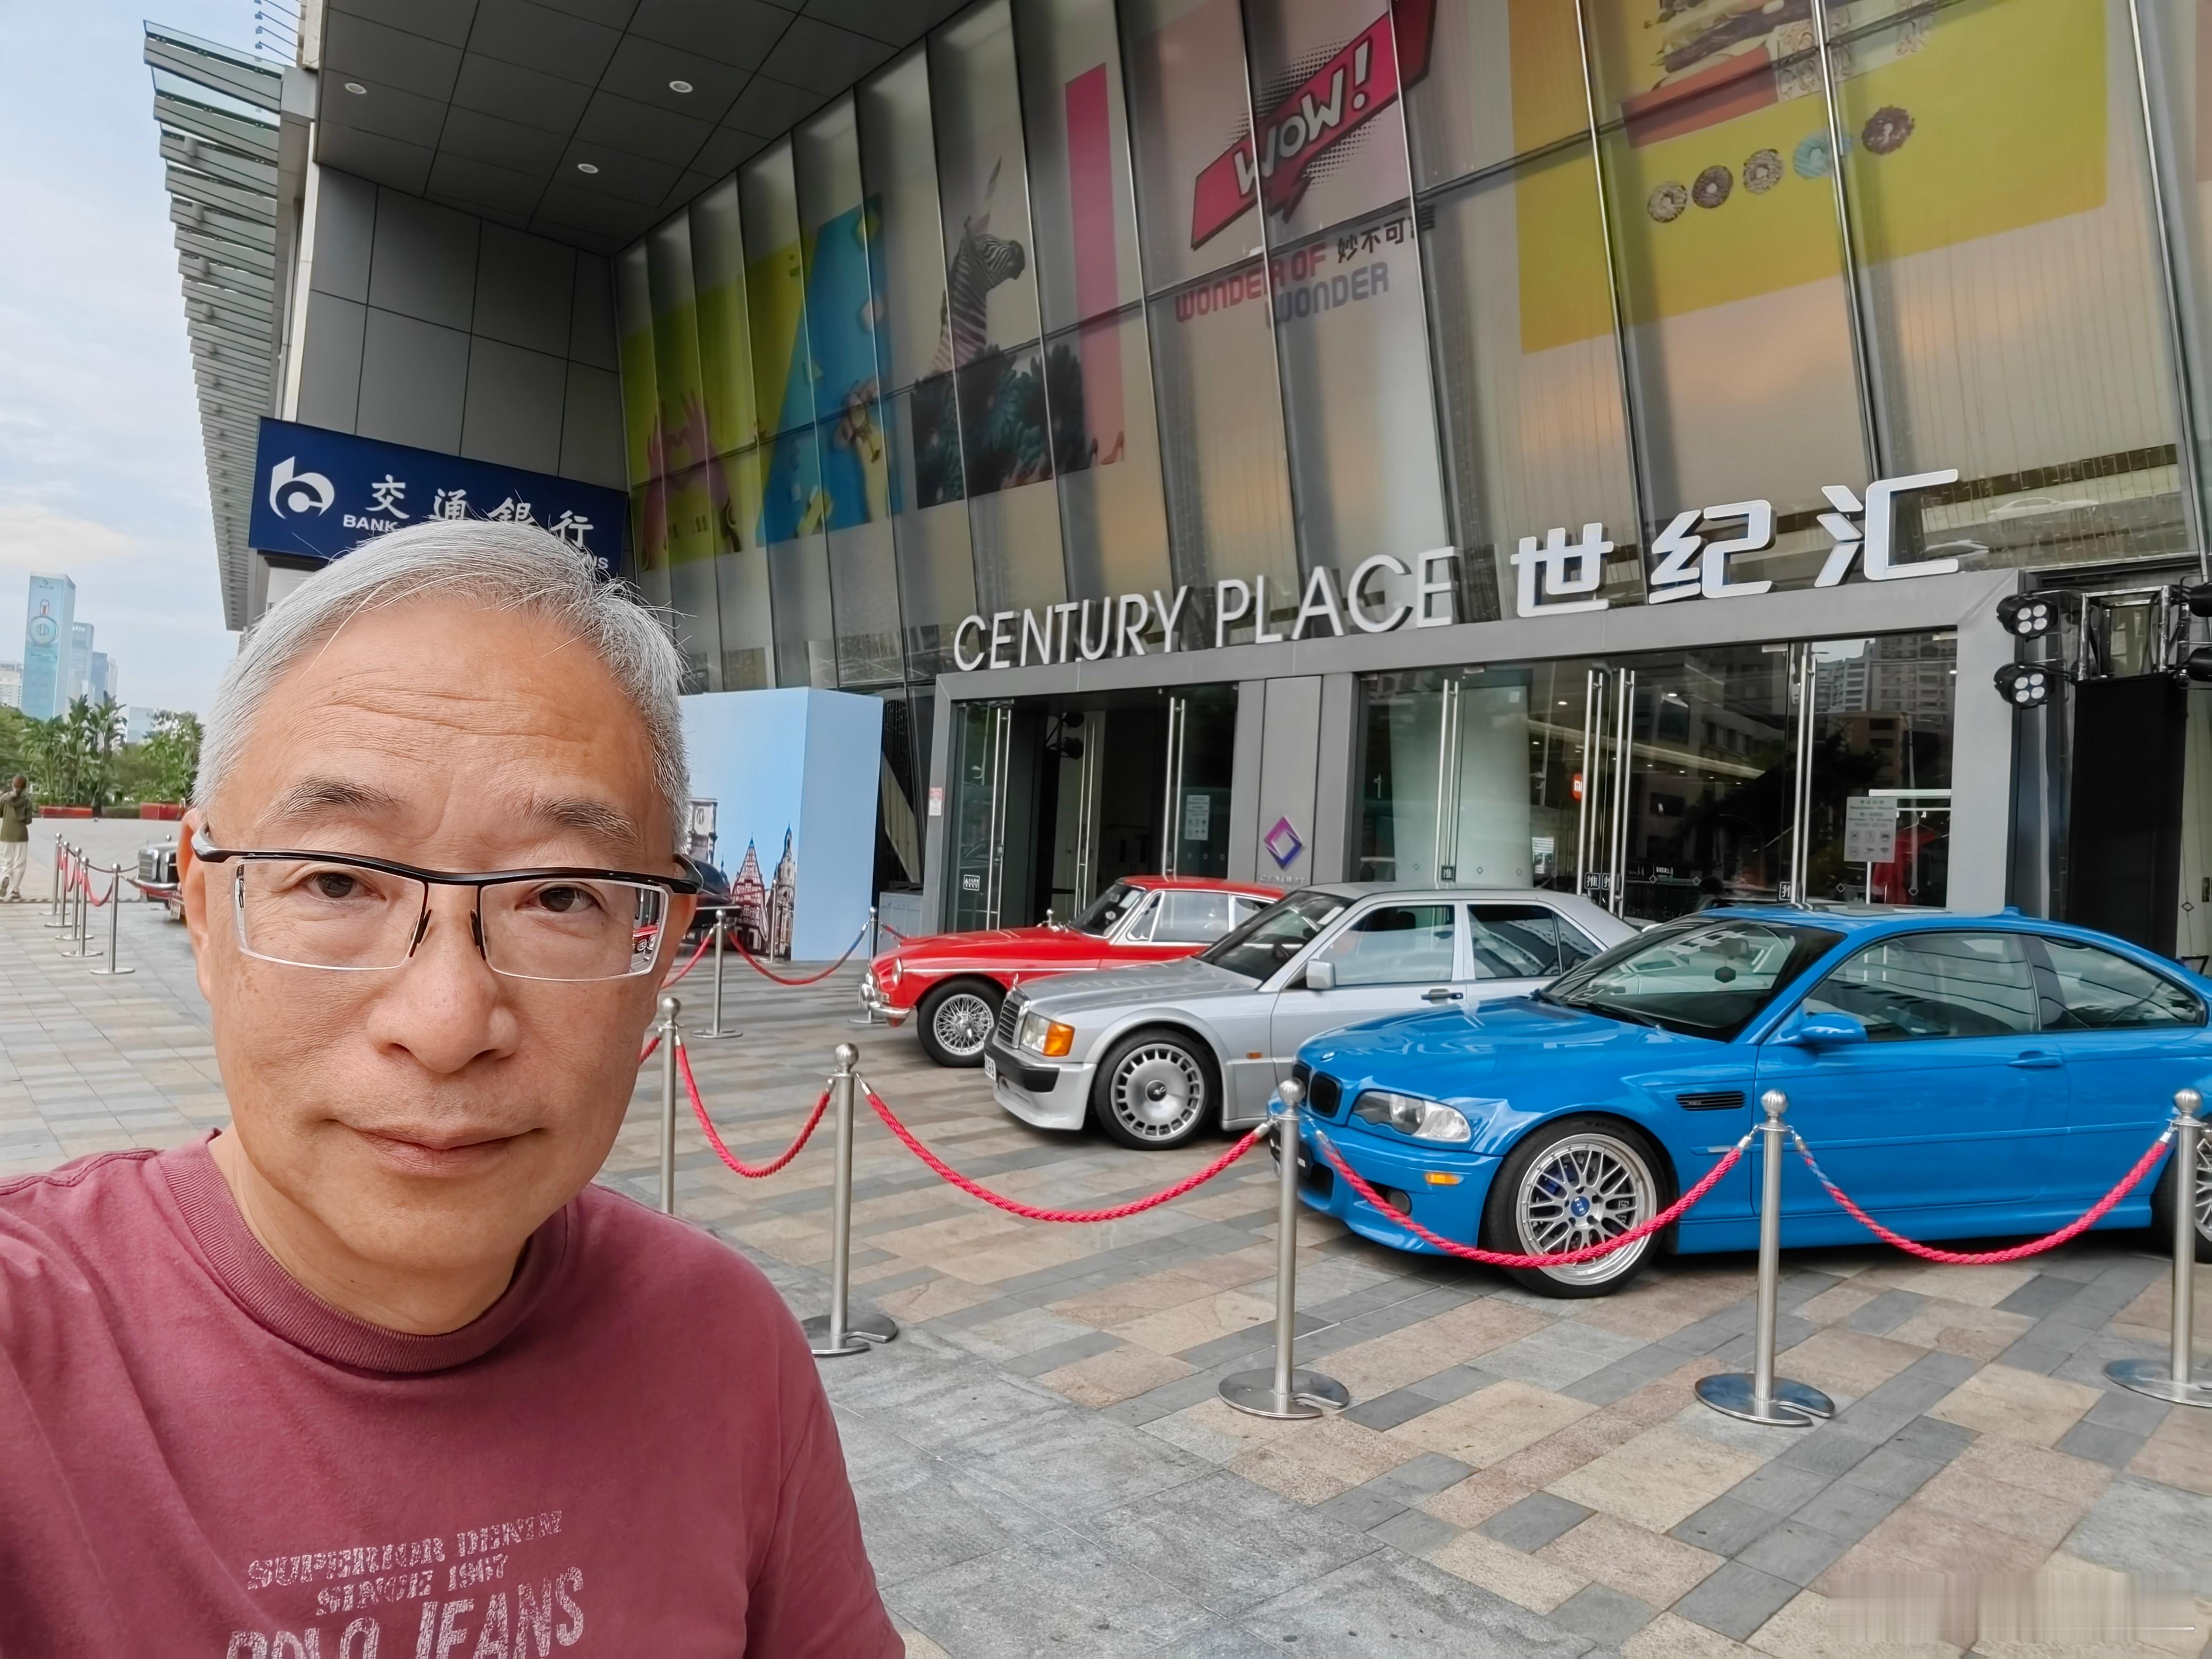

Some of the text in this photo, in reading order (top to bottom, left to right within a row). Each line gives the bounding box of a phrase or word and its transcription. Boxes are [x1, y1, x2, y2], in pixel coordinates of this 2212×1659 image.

[1233, 39, 1370, 197] WOW!
[1175, 242, 1326, 323] WONDER OF
[1265, 262, 1389, 330] WONDER
[343, 514, 398, 532] BANK
[954, 469, 1959, 672] CENTURY PLACE 世纪汇
[1587, 875, 1598, 887] 推
